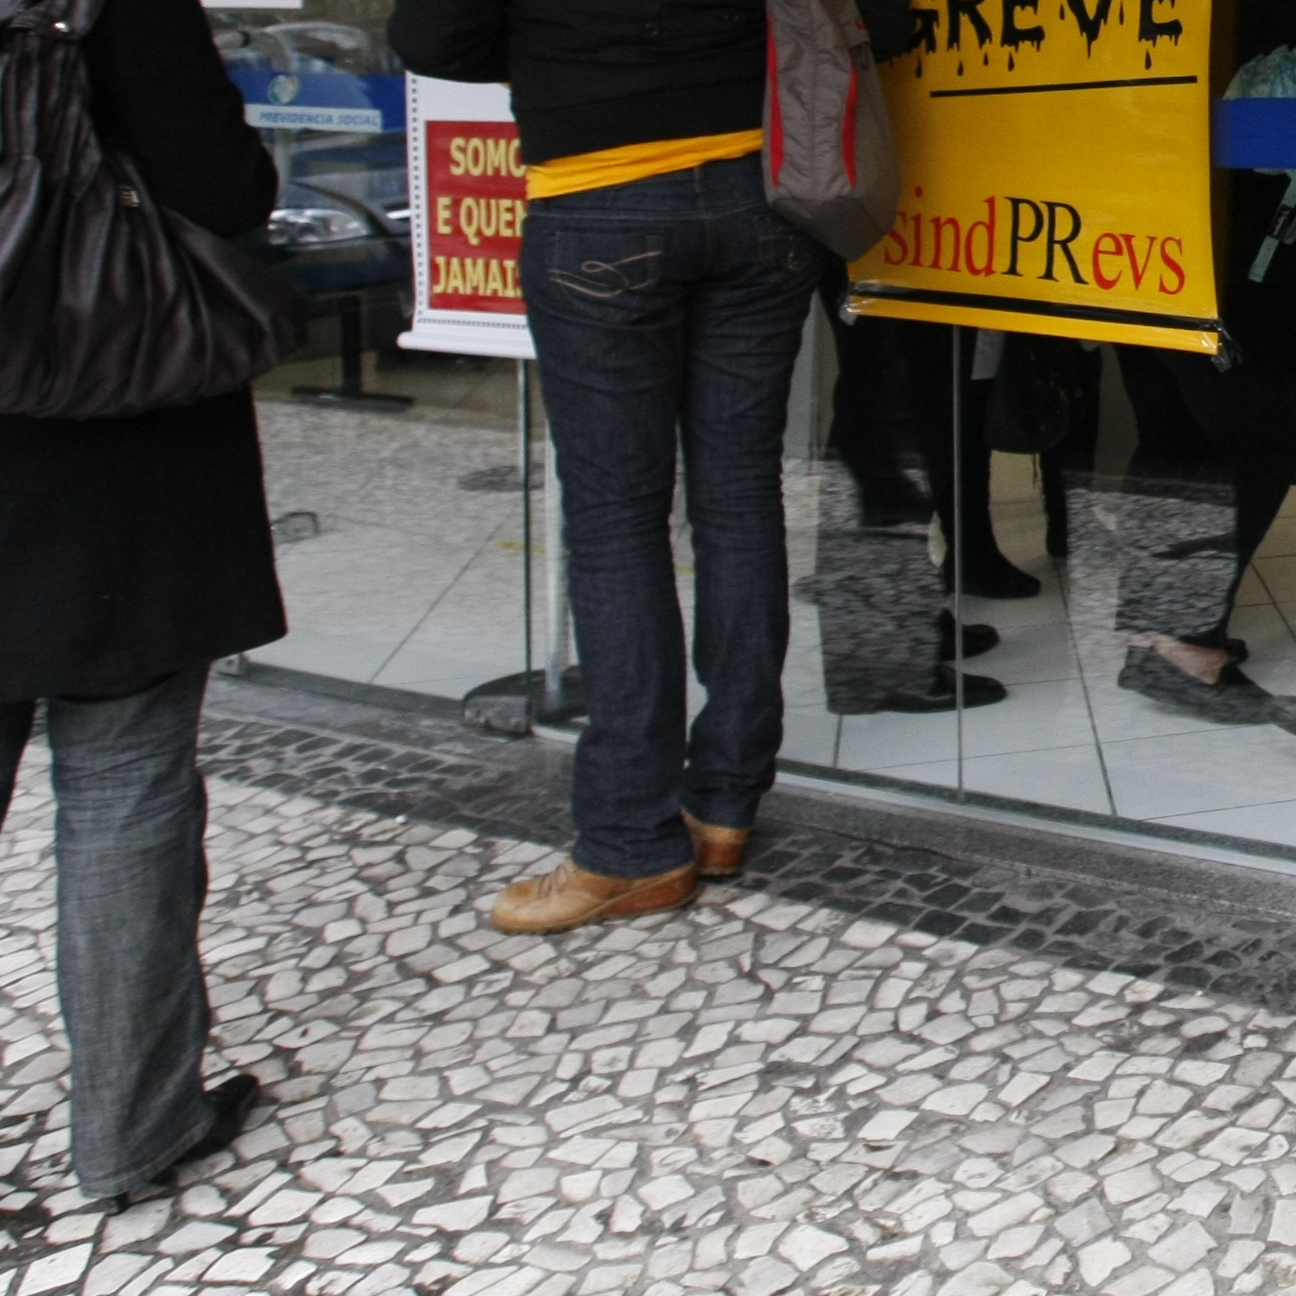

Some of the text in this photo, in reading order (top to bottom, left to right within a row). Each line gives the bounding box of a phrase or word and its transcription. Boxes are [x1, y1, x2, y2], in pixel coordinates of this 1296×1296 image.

[436, 196, 453, 235] E
[884, 186, 1186, 296] sindPRevs
[433, 255, 523, 299] JAMAI
